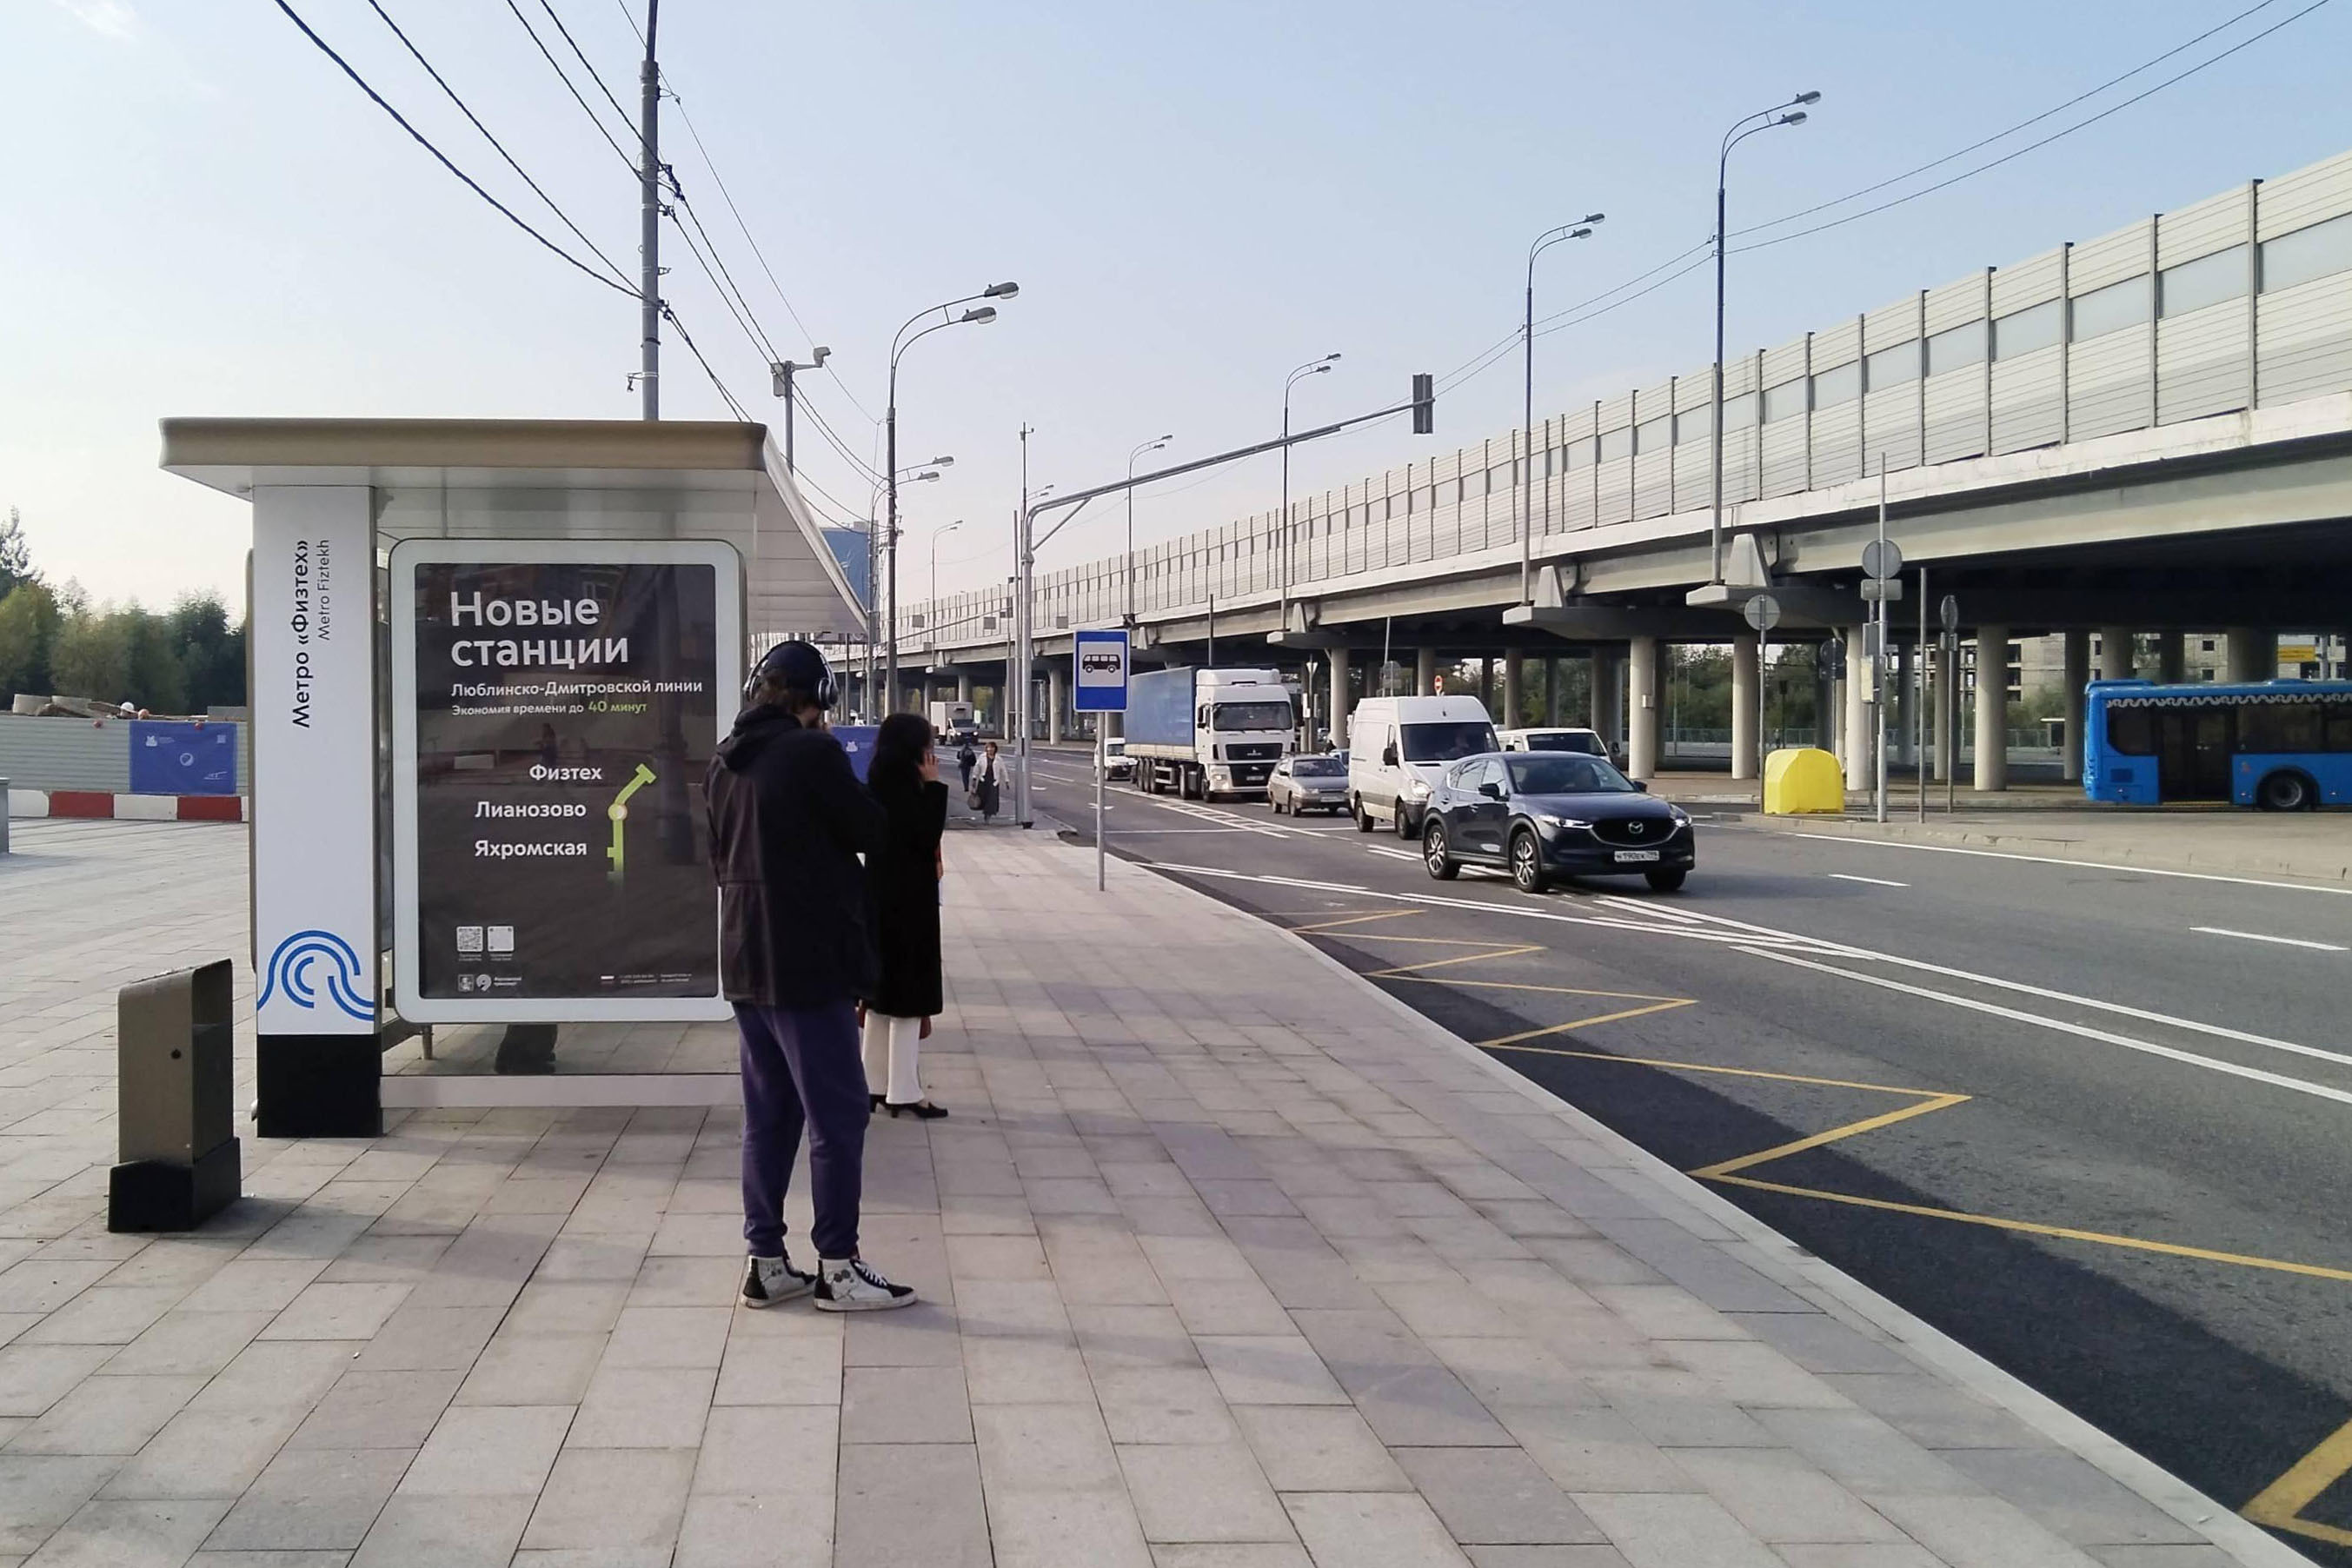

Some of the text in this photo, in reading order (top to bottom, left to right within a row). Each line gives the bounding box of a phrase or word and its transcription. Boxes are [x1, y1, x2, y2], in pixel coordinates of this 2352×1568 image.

[316, 539, 330, 641] Metro Fiztekh
[450, 591, 600, 627] Новые
[291, 540, 314, 728] Метро «Физтех»
[451, 637, 628, 670] станции
[451, 680, 702, 697] Люблинско-Дмитровской линии
[451, 701, 648, 716] Экономия времени до 40 минут
[528, 763, 602, 781] Физтех
[475, 801, 587, 818] Лианозово
[475, 840, 588, 860] Яхромская
